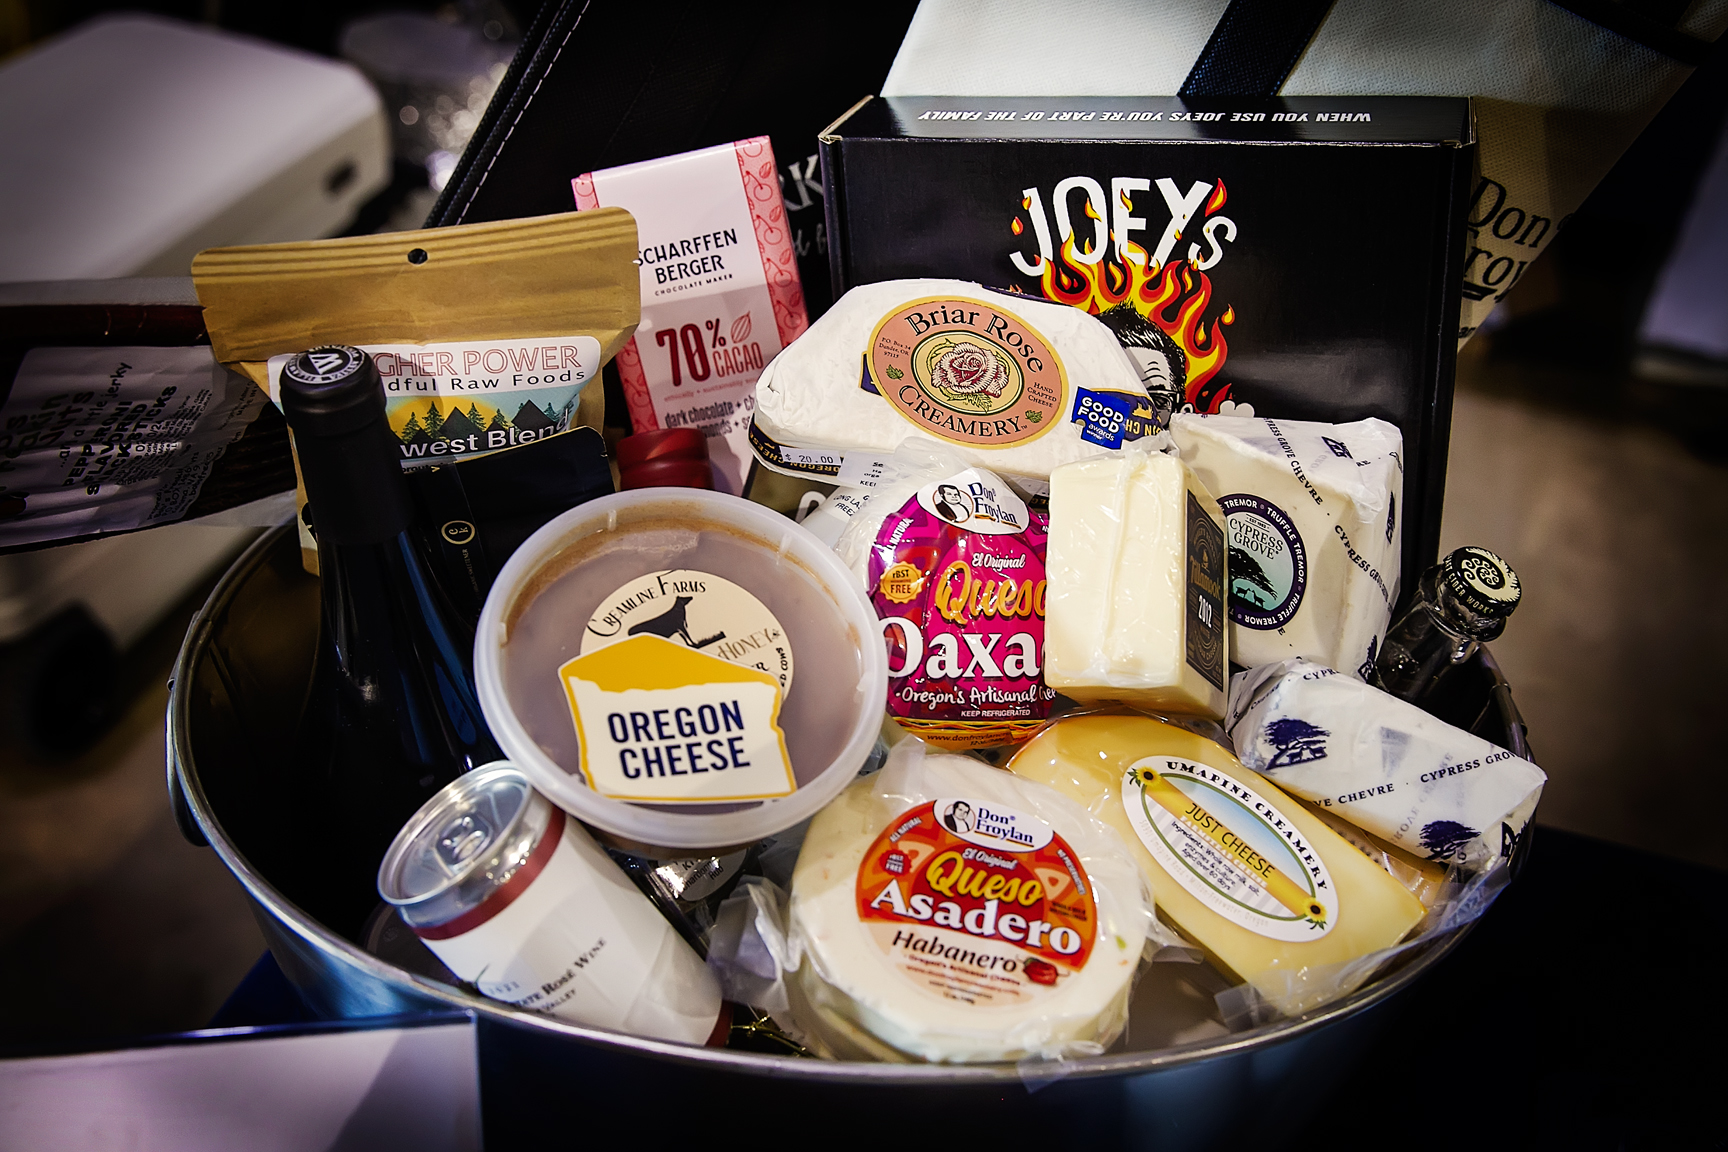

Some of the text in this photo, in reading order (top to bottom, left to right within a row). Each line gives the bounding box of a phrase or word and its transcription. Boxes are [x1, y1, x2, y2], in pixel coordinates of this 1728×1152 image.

[917, 110, 1372, 123] WHEN YOU USE JOEYS YOU'RE PART OF THE FAMILY
[1468, 176, 1551, 248] Don
[654, 273, 733, 296] CHOCOLATE MAKER
[655, 254, 725, 284] BERGER
[904, 305, 1044, 374] Briar Rose
[377, 351, 455, 377] GHER
[463, 345, 582, 375] POWER
[712, 342, 764, 378] CACAO
[103, 361, 133, 404] jerky
[388, 369, 585, 392] dful Raw Foods
[1027, 386, 1057, 403] CRAFTED
[1033, 381, 1054, 394] HAND
[131, 385, 177, 442] STICKS
[665, 408, 688, 429] dark
[688, 400, 734, 425] chocolate
[898, 385, 1022, 437] CREAMERY
[1028, 394, 1054, 409] CHEESE
[1081, 396, 1124, 422] GOOD
[487, 408, 572, 448] Blend
[1077, 406, 1119, 433] FOOD
[1086, 429, 1104, 441] winner
[1088, 423, 1115, 441] awards
[62, 400, 133, 487] PEPPERONI
[83, 402, 148, 484] FLAVORED
[1276, 436, 1296, 460] GROVE
[1290, 459, 1324, 506] CHEVRE
[968, 482, 993, 499] Don
[974, 499, 1018, 525] Froylan
[1223, 498, 1305, 584] TREMOR TRUFFLE TREMOR
[1229, 517, 1284, 552] CYPRESS
[1233, 531, 1276, 560] GROVE
[1334, 524, 1372, 573] CYPRESS
[891, 569, 910, 579] rBST
[972, 553, 1026, 572] El Original
[890, 584, 912, 594] FREE
[1448, 572, 1466, 597] CIDER
[586, 570, 706, 637] CREAMLINE FARMS
[1243, 592, 1301, 627] TRUFFLE TREMOR
[717, 628, 772, 661] HONEY
[878, 617, 1045, 680] Oaxa
[1303, 668, 1341, 681] CYPR
[902, 686, 965, 709] Oregon's
[969, 684, 1038, 704] Artisanal
[607, 700, 745, 744] OREGON
[960, 709, 1032, 718] KEEP REFRIGERATED
[619, 736, 751, 779] CHEESE
[1337, 783, 1395, 804] CHEVRE
[1420, 759, 1481, 784] CYPRESS
[975, 820, 1034, 844] Froylan
[978, 807, 1009, 825] Don
[1166, 760, 1328, 890] UMAPINE CREAMERY
[1185, 803, 1276, 879] JUST CHEESE
[1204, 848, 1223, 865] Whole
[962, 847, 1018, 870] El Original
[1180, 847, 1197, 864] Aged
[1195, 859, 1210, 873] over
[1216, 876, 1232, 891] days
[925, 850, 1046, 907] Queso
[870, 878, 1082, 955] Asadero
[892, 930, 1017, 973] Habanero
